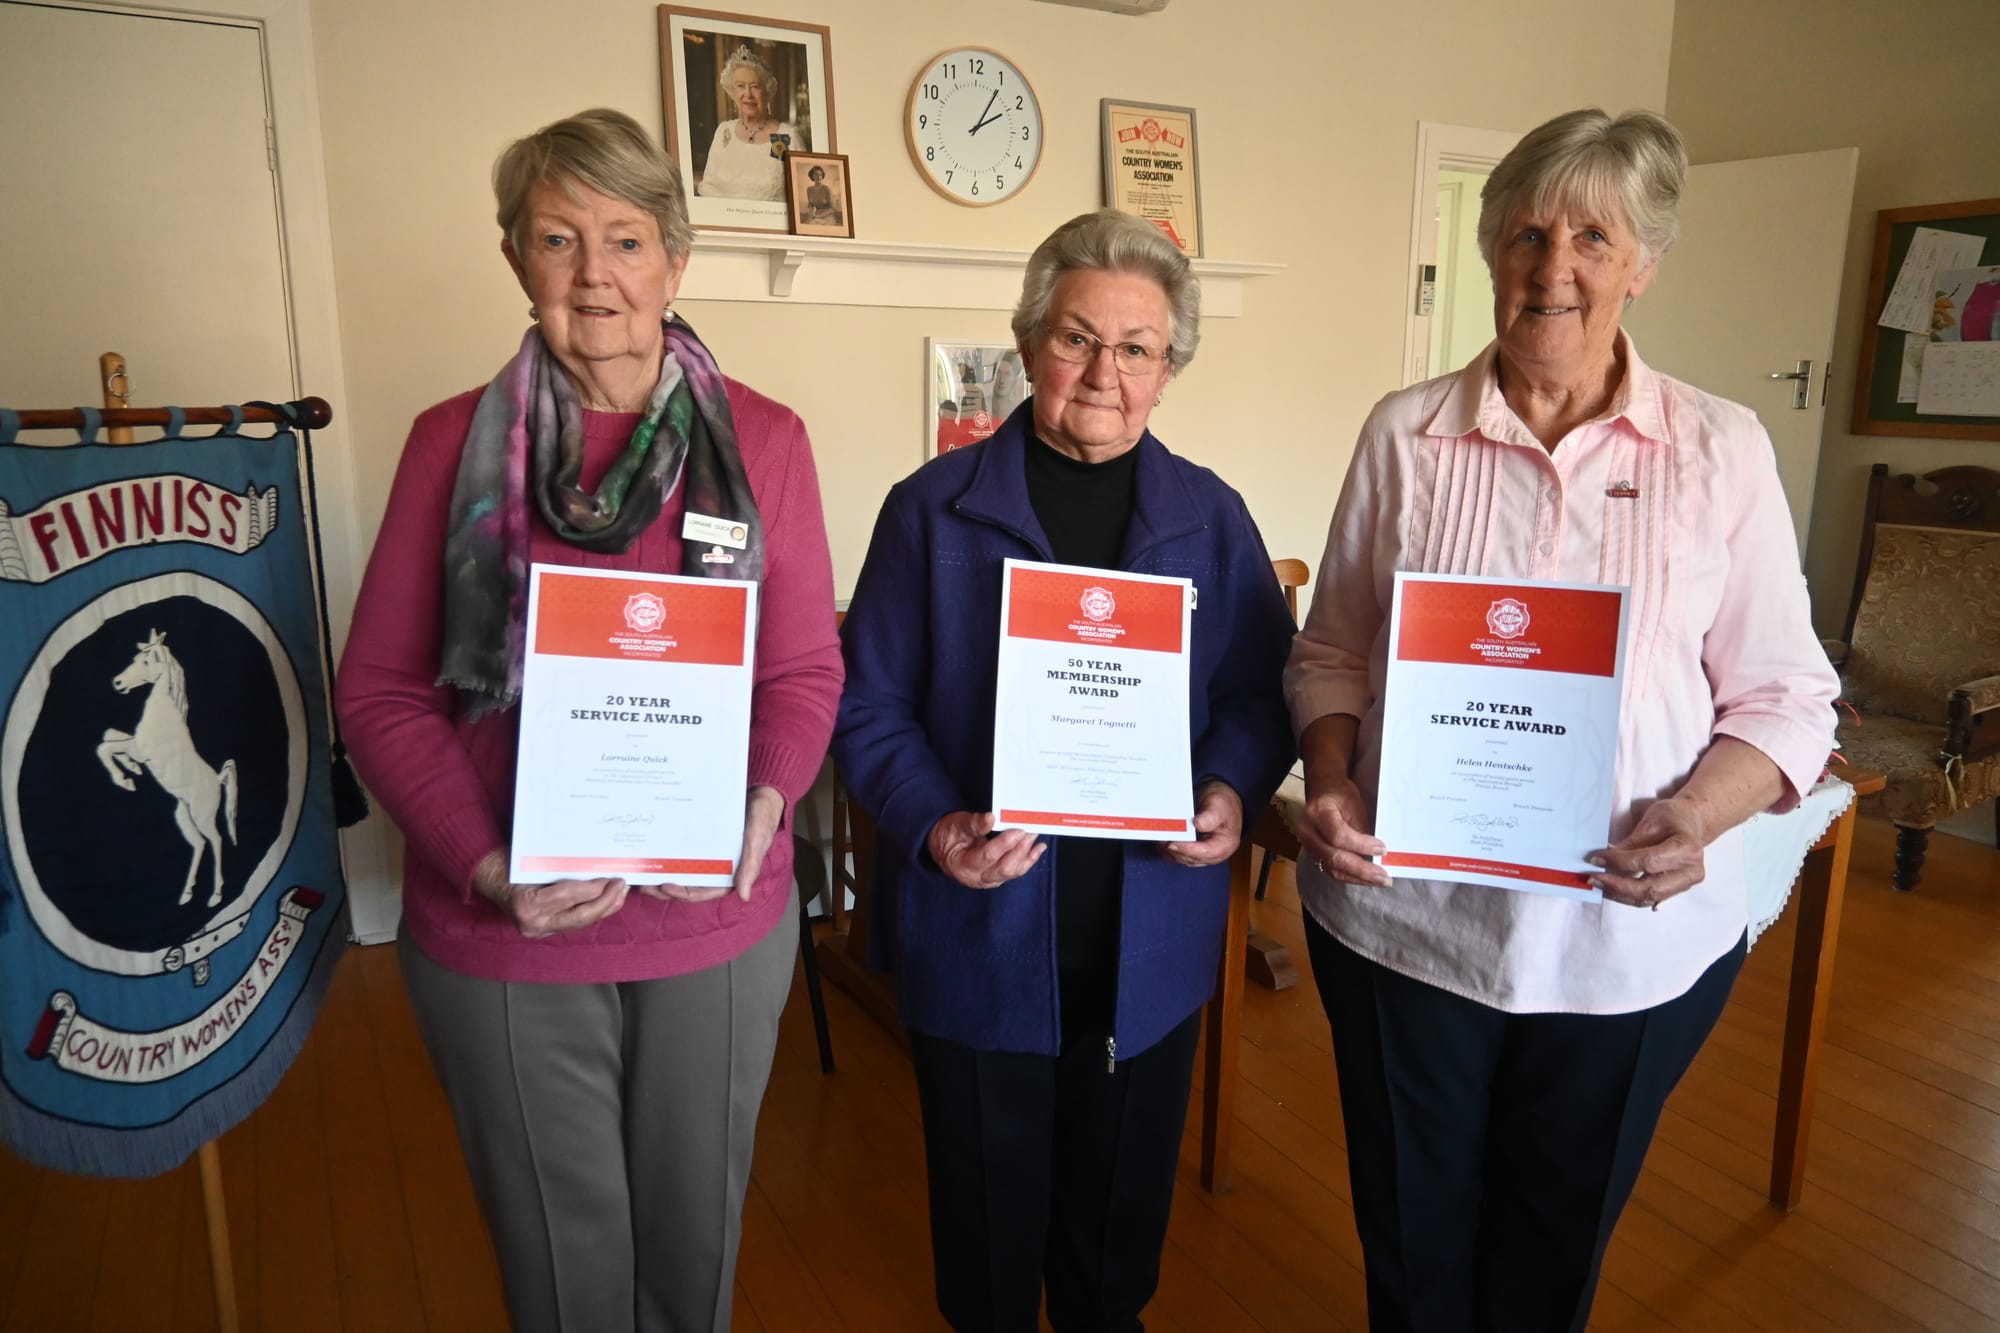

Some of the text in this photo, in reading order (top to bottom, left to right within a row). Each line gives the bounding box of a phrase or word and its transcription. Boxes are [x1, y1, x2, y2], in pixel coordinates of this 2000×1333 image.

[943, 64, 956, 79] 11
[969, 58, 984, 74] 12
[998, 71, 1003, 86] 1
[924, 84, 939, 100] 10
[1015, 96, 1023, 110] 2
[919, 114, 927, 130] 9
[1022, 126, 1030, 141] 3
[926, 146, 934, 161] 8
[1014, 155, 1022, 170] 4
[1122, 156, 1183, 170] COUNTRY WOMEN'S
[946, 170, 953, 185] 7
[996, 176, 1004, 190] 5
[1134, 170, 1174, 182] ASSOCIATION
[971, 180, 979, 195] 6
[30, 479, 242, 573] FINNISS
[608, 637, 642, 645] COUNTRY
[1077, 630, 1117, 639] ASSOCIATION
[620, 644, 666, 652] ASSOCIATION
[1470, 643, 1541, 654] COUNTRY WOMEN'S
[1481, 650, 1529, 659] ASSOCIATION
[1068, 658, 1122, 671] 50 YEAR
[1047, 670, 1142, 686] MEMBERSHIP
[1069, 686, 1119, 698] AWARD
[606, 695, 670, 708] 20 YEAR
[1466, 701, 1533, 716] 20 YEAR
[570, 709, 703, 725] SERVICE AWARD
[1051, 715, 1136, 728] Margaret Tognetti
[1431, 714, 1566, 736] SERVICE AWARD
[601, 754, 668, 764] Lorraine Quick
[1456, 758, 1533, 772] Helen Hentschke
[65, 1029, 176, 1074] COUNTRY
[181, 978, 257, 1056] WOMEN'S
